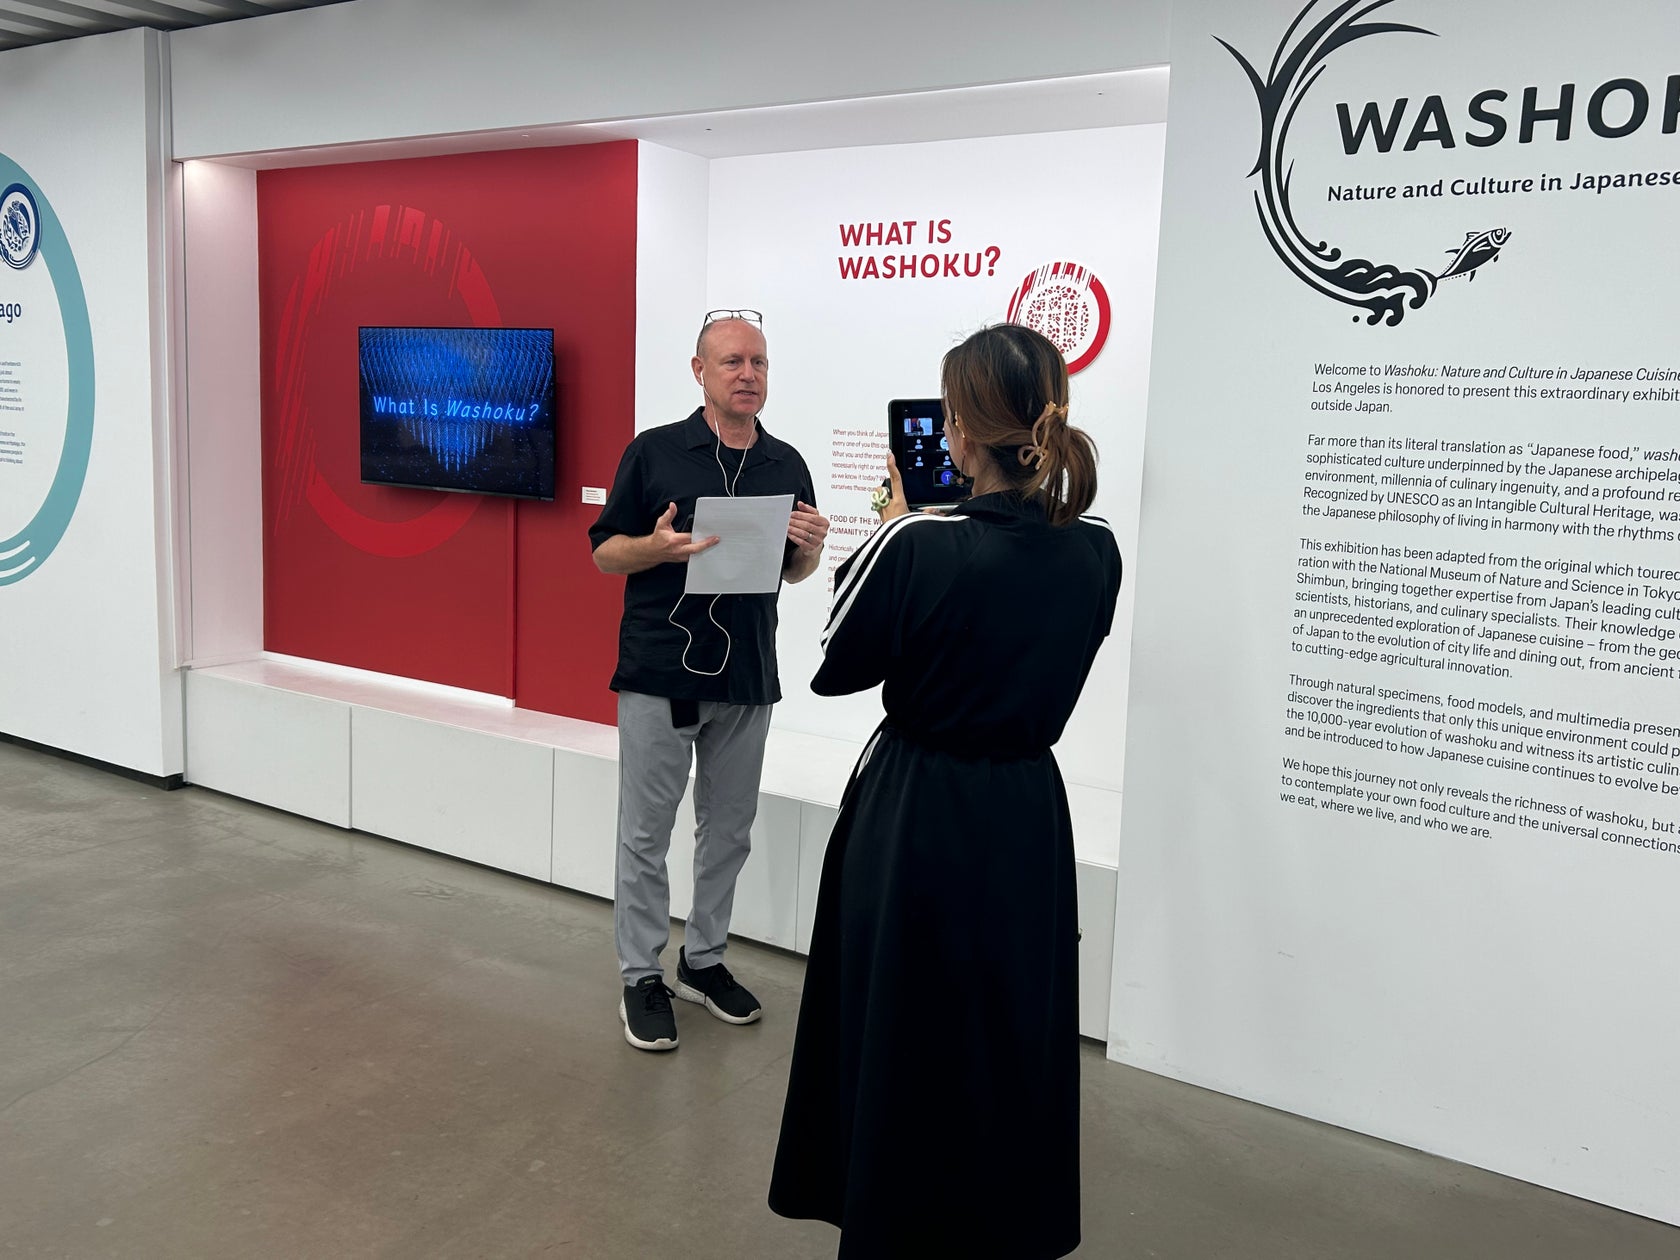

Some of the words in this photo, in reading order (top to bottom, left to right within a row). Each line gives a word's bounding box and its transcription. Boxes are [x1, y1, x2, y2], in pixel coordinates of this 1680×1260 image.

[1327, 184, 1397, 202] Nature
[1402, 179, 1444, 199] and
[1450, 176, 1534, 196] Culture
[1540, 173, 1563, 191] in
[839, 221, 917, 247] WHAT
[928, 219, 952, 244] IS
[838, 245, 1001, 279] WASHOKU?
[1314, 363, 1367, 376] Welcome
[1369, 364, 1382, 377] to
[1384, 364, 1439, 378] Washoku:
[1440, 365, 1481, 379] Nature
[1482, 365, 1508, 379] and
[1508, 365, 1554, 380] Culture
[1555, 366, 1568, 380] in
[1569, 367, 1634, 383] Japanese
[1310, 399, 1353, 412] outside
[1354, 400, 1393, 415] Japan.
[1312, 380, 1332, 394] Los
[1333, 381, 1381, 396] Angeles
[1382, 382, 1393, 395] is
[1394, 382, 1445, 396] honored
[1447, 384, 1461, 397] to
[1462, 385, 1511, 399] present
[1513, 385, 1537, 399] this
[1540, 386, 1630, 403] extraordinary
[373, 396, 415, 415] What
[424, 398, 438, 416] Is
[446, 399, 539, 422] Washoku?
[1307, 433, 1326, 446] Far
[1327, 437, 1358, 448] more
[1359, 435, 1386, 449] than
[1388, 436, 1403, 450] its
[1404, 437, 1438, 451] literal
[1440, 439, 1506, 454] translation
[1508, 445, 1523, 456] as
[1527, 442, 1595, 459] “Japanese
[1598, 445, 1640, 462] food,”
[1306, 452, 1383, 467] sophisticated
[1384, 455, 1425, 469] culture
[1427, 457, 1505, 474] underpinned
[1506, 460, 1523, 477] by
[1524, 461, 1546, 476] the
[1548, 463, 1613, 479] Japanese
[1304, 469, 1378, 487] environment,
[1380, 473, 1432, 488] millennia
[1434, 475, 1449, 489] of
[1449, 477, 1498, 494] culinary
[1499, 479, 1561, 498] ingenuity,
[1564, 483, 1590, 497] and
[1591, 487, 1600, 498] a
[1602, 485, 1665, 502] profound
[829, 514, 848, 523] FOOD
[849, 516, 858, 524] OF
[859, 517, 872, 526] THE
[1303, 486, 1369, 503] Recognized
[1370, 489, 1385, 505] by
[1386, 491, 1440, 507] UNESCO
[1441, 497, 1456, 508] as
[1457, 498, 1473, 509] an
[1475, 497, 1537, 514] Intangible
[1539, 500, 1590, 516] Cultural
[1592, 504, 1654, 523] Heritage,
[829, 527, 869, 537] HUMANITY'S
[1302, 503, 1321, 516] the
[1322, 505, 1377, 520] Japanese
[1377, 508, 1441, 527] philosophy
[1442, 513, 1456, 526] of
[1457, 513, 1489, 531] living
[1490, 516, 1502, 529] in
[1504, 516, 1560, 536] harmony
[1562, 521, 1590, 536] with
[1592, 523, 1615, 538] the
[1617, 524, 1674, 542] rhythms
[1296, 572, 1349, 590] Shimbun,
[1351, 576, 1399, 596] bringing
[1401, 582, 1454, 598] together
[1455, 590, 1514, 605] expertise
[1516, 592, 1547, 608] from
[1549, 596, 1599, 613] Japan’s
[1601, 600, 1652, 621] leading
[1295, 590, 1351, 608] scientists,
[1354, 594, 1413, 615] historians,
[1415, 602, 1439, 615] and
[1440, 604, 1489, 623] culinary
[1490, 611, 1560, 628] specialists.
[1564, 616, 1598, 632] Their
[1600, 619, 1676, 642] knowledge
[1291, 640, 1303, 652] to
[1304, 644, 1378, 663] cutting-edge
[1379, 652, 1445, 670] agricultural
[1447, 658, 1513, 679] innovation.
[1289, 673, 1334, 692] Through
[1336, 682, 1376, 697] natural
[1377, 688, 1444, 707] specimens,
[1447, 694, 1476, 710] food
[1477, 701, 1526, 719] models,
[1529, 708, 1554, 721] and
[1556, 711, 1630, 731] multimedia
[1286, 707, 1305, 721] the
[1307, 710, 1373, 730] 10,000-year
[1374, 722, 1427, 739] evolution
[1429, 728, 1443, 741] of
[1444, 733, 1498, 750] washoku
[1499, 741, 1524, 753] and
[1525, 743, 1575, 761] witness
[1577, 749, 1594, 764] its
[1596, 754, 1644, 771] artistic
[1279, 792, 1296, 804] we
[1297, 796, 1318, 809] eat,
[1320, 798, 1355, 814] where
[1356, 806, 1374, 818] we
[1375, 806, 1397, 824] live,
[1399, 814, 1422, 826] and
[1423, 817, 1449, 831] who
[1450, 823, 1469, 835] we
[1470, 826, 1493, 839] are.
